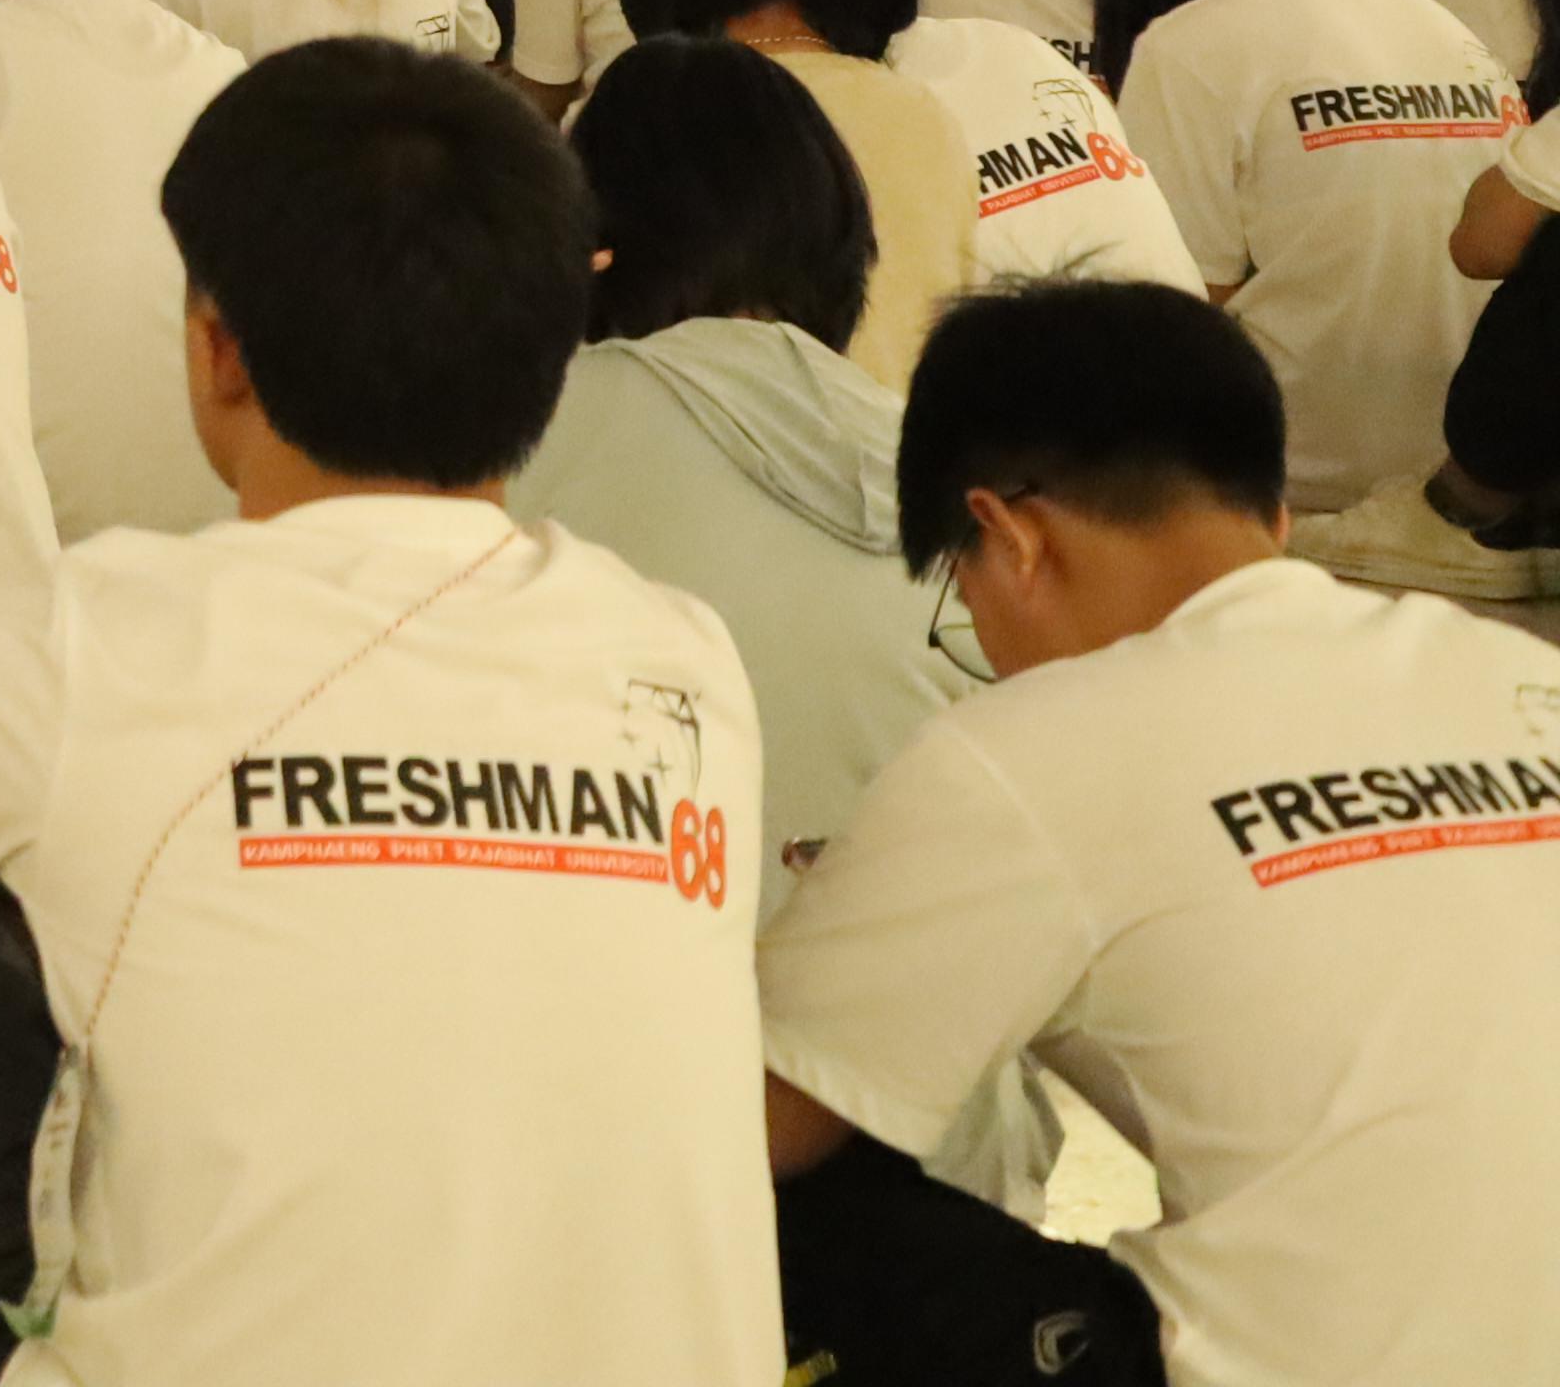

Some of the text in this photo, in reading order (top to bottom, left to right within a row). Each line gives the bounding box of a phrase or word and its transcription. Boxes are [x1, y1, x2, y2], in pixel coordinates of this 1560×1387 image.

[1290, 83, 1498, 132] FRESHMAN
[978, 128, 1089, 195] HMAN
[231, 754, 727, 909] FRESHMAN 68
[390, 841, 445, 861] PHET
